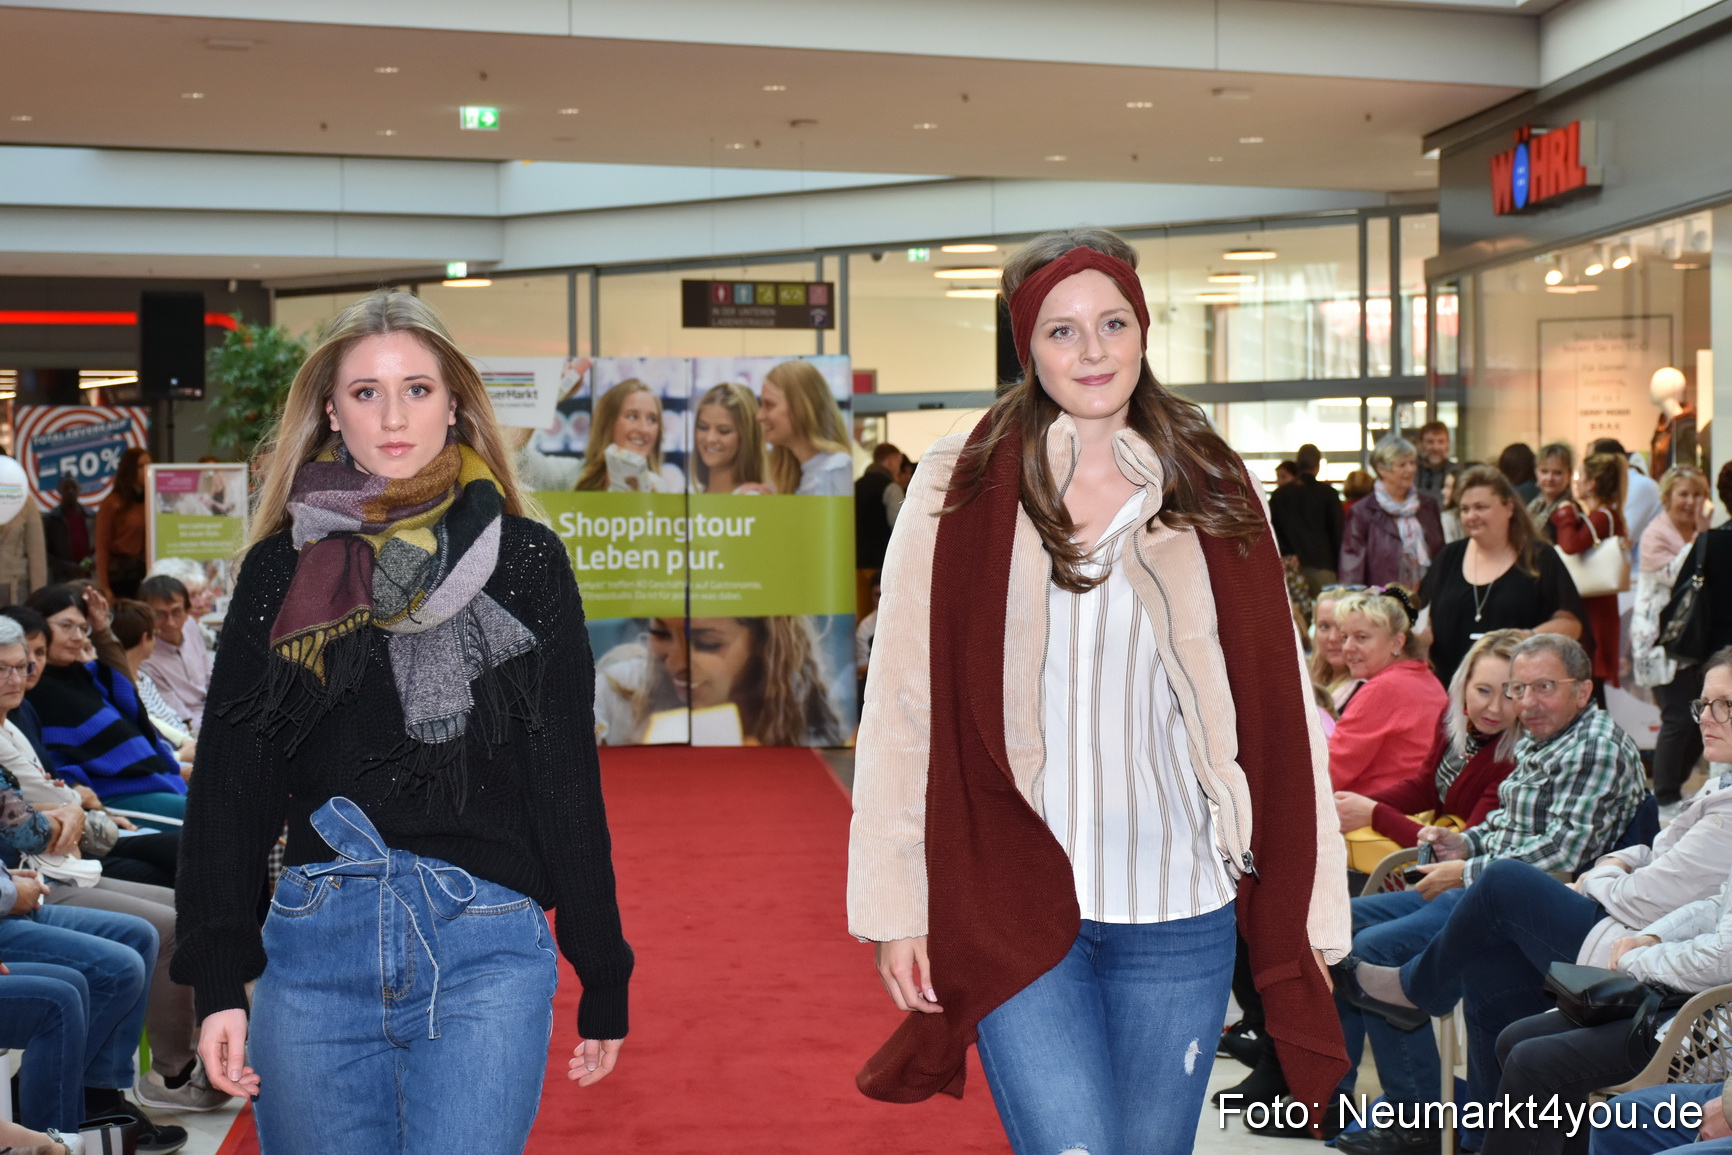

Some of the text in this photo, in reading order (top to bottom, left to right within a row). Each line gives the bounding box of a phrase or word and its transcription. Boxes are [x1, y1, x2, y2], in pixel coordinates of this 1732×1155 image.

[1490, 121, 1587, 216] WÖHRL
[559, 511, 756, 543] Shoppingtour
[576, 544, 724, 575] Leben pur.
